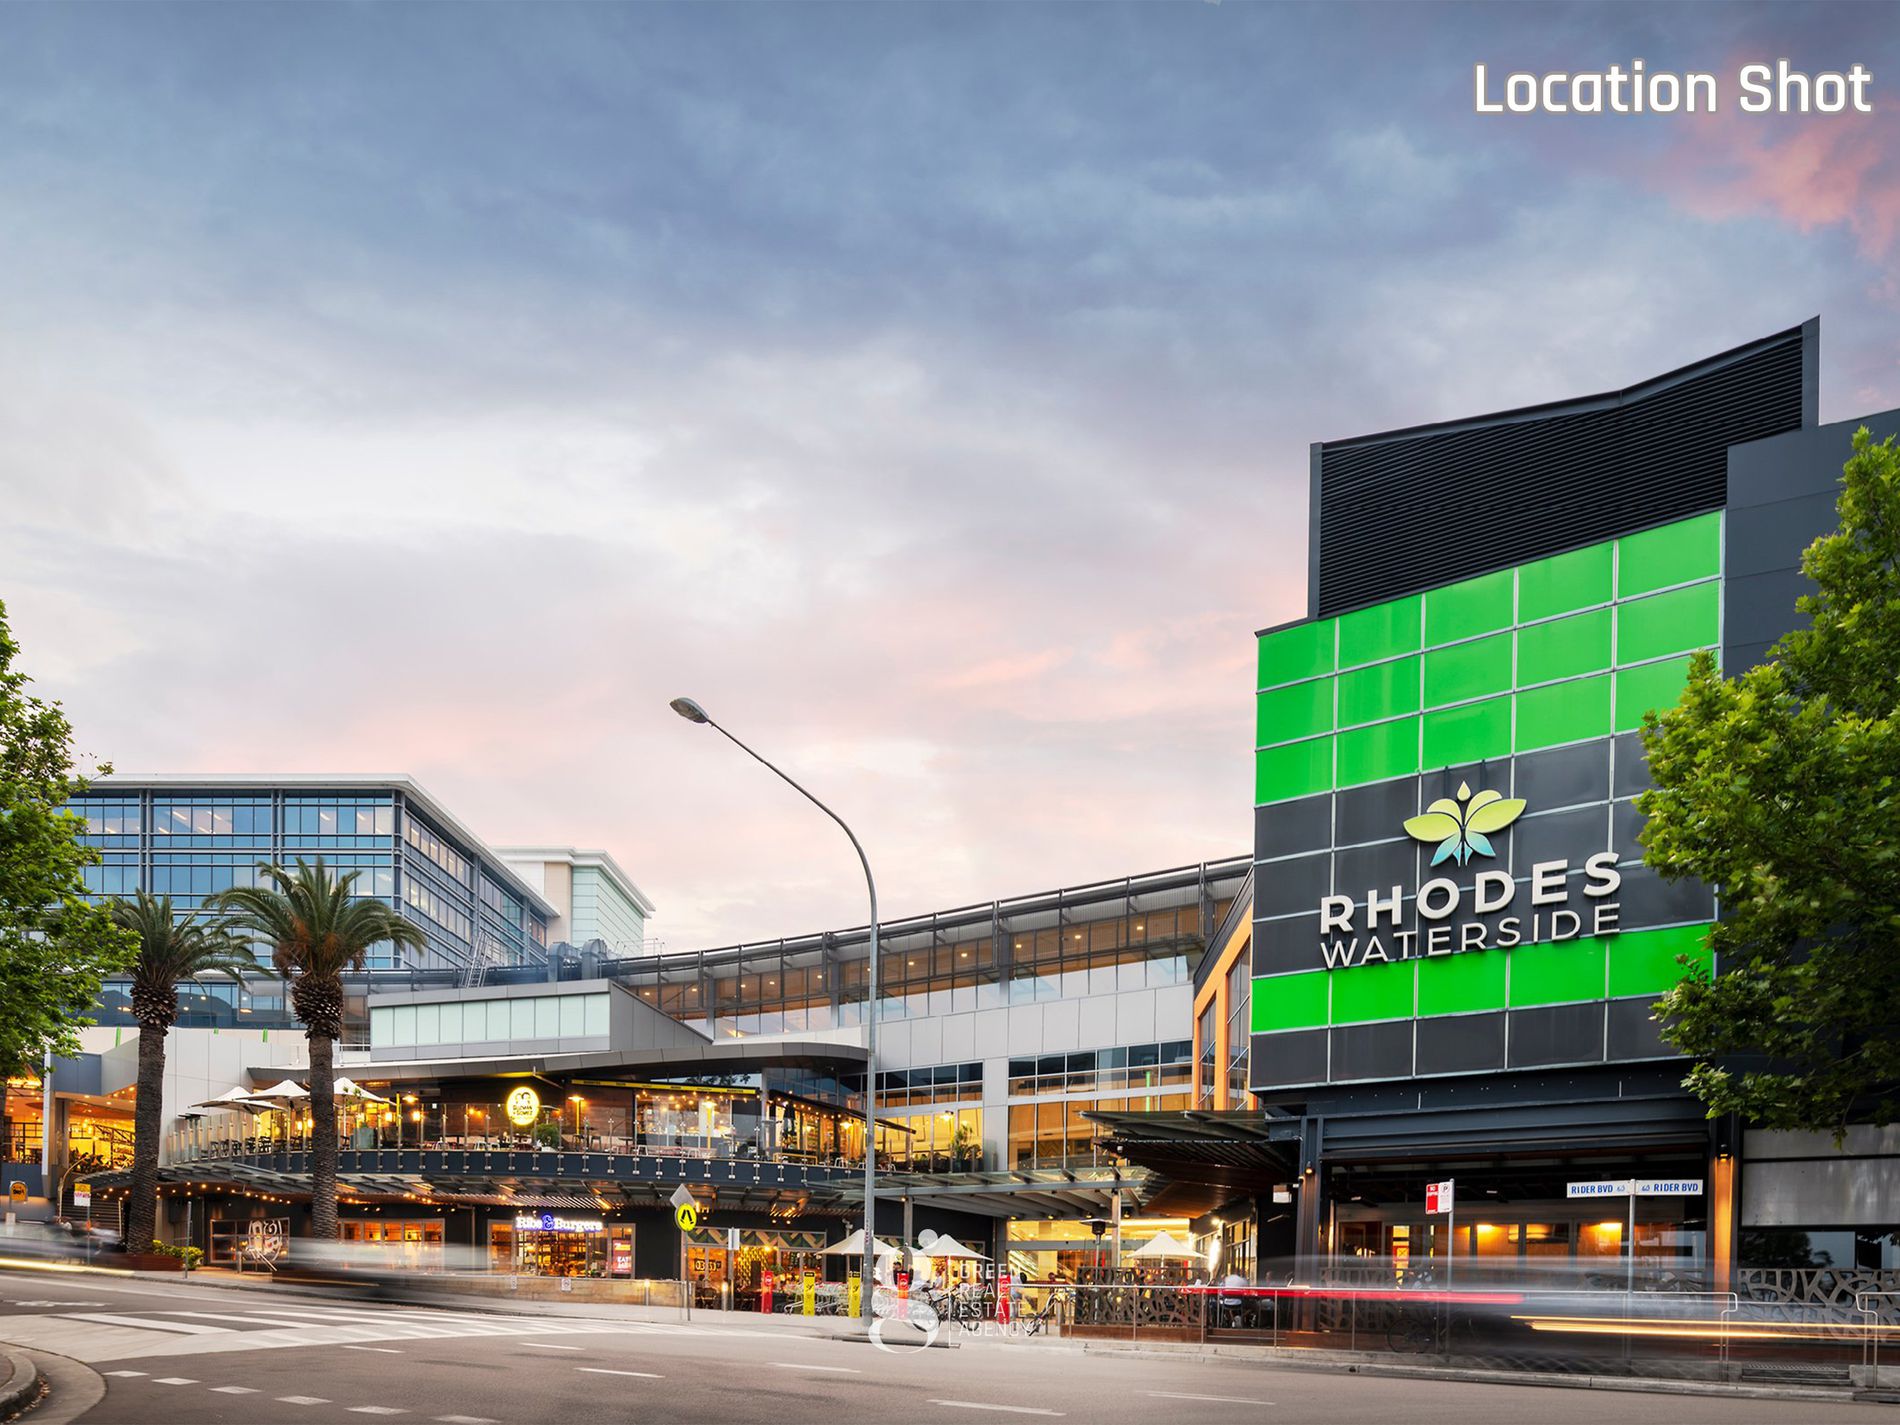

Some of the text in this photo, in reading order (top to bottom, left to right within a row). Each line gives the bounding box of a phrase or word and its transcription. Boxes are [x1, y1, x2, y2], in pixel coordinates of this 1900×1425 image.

[1320, 852, 1621, 935] RHODES
[1320, 903, 1620, 969] WATERSIDE
[1571, 1185, 1613, 1194] RIDER BVD
[1654, 1183, 1698, 1192] RIDER BVD
[516, 1214, 603, 1232] Ribs & Burgers
